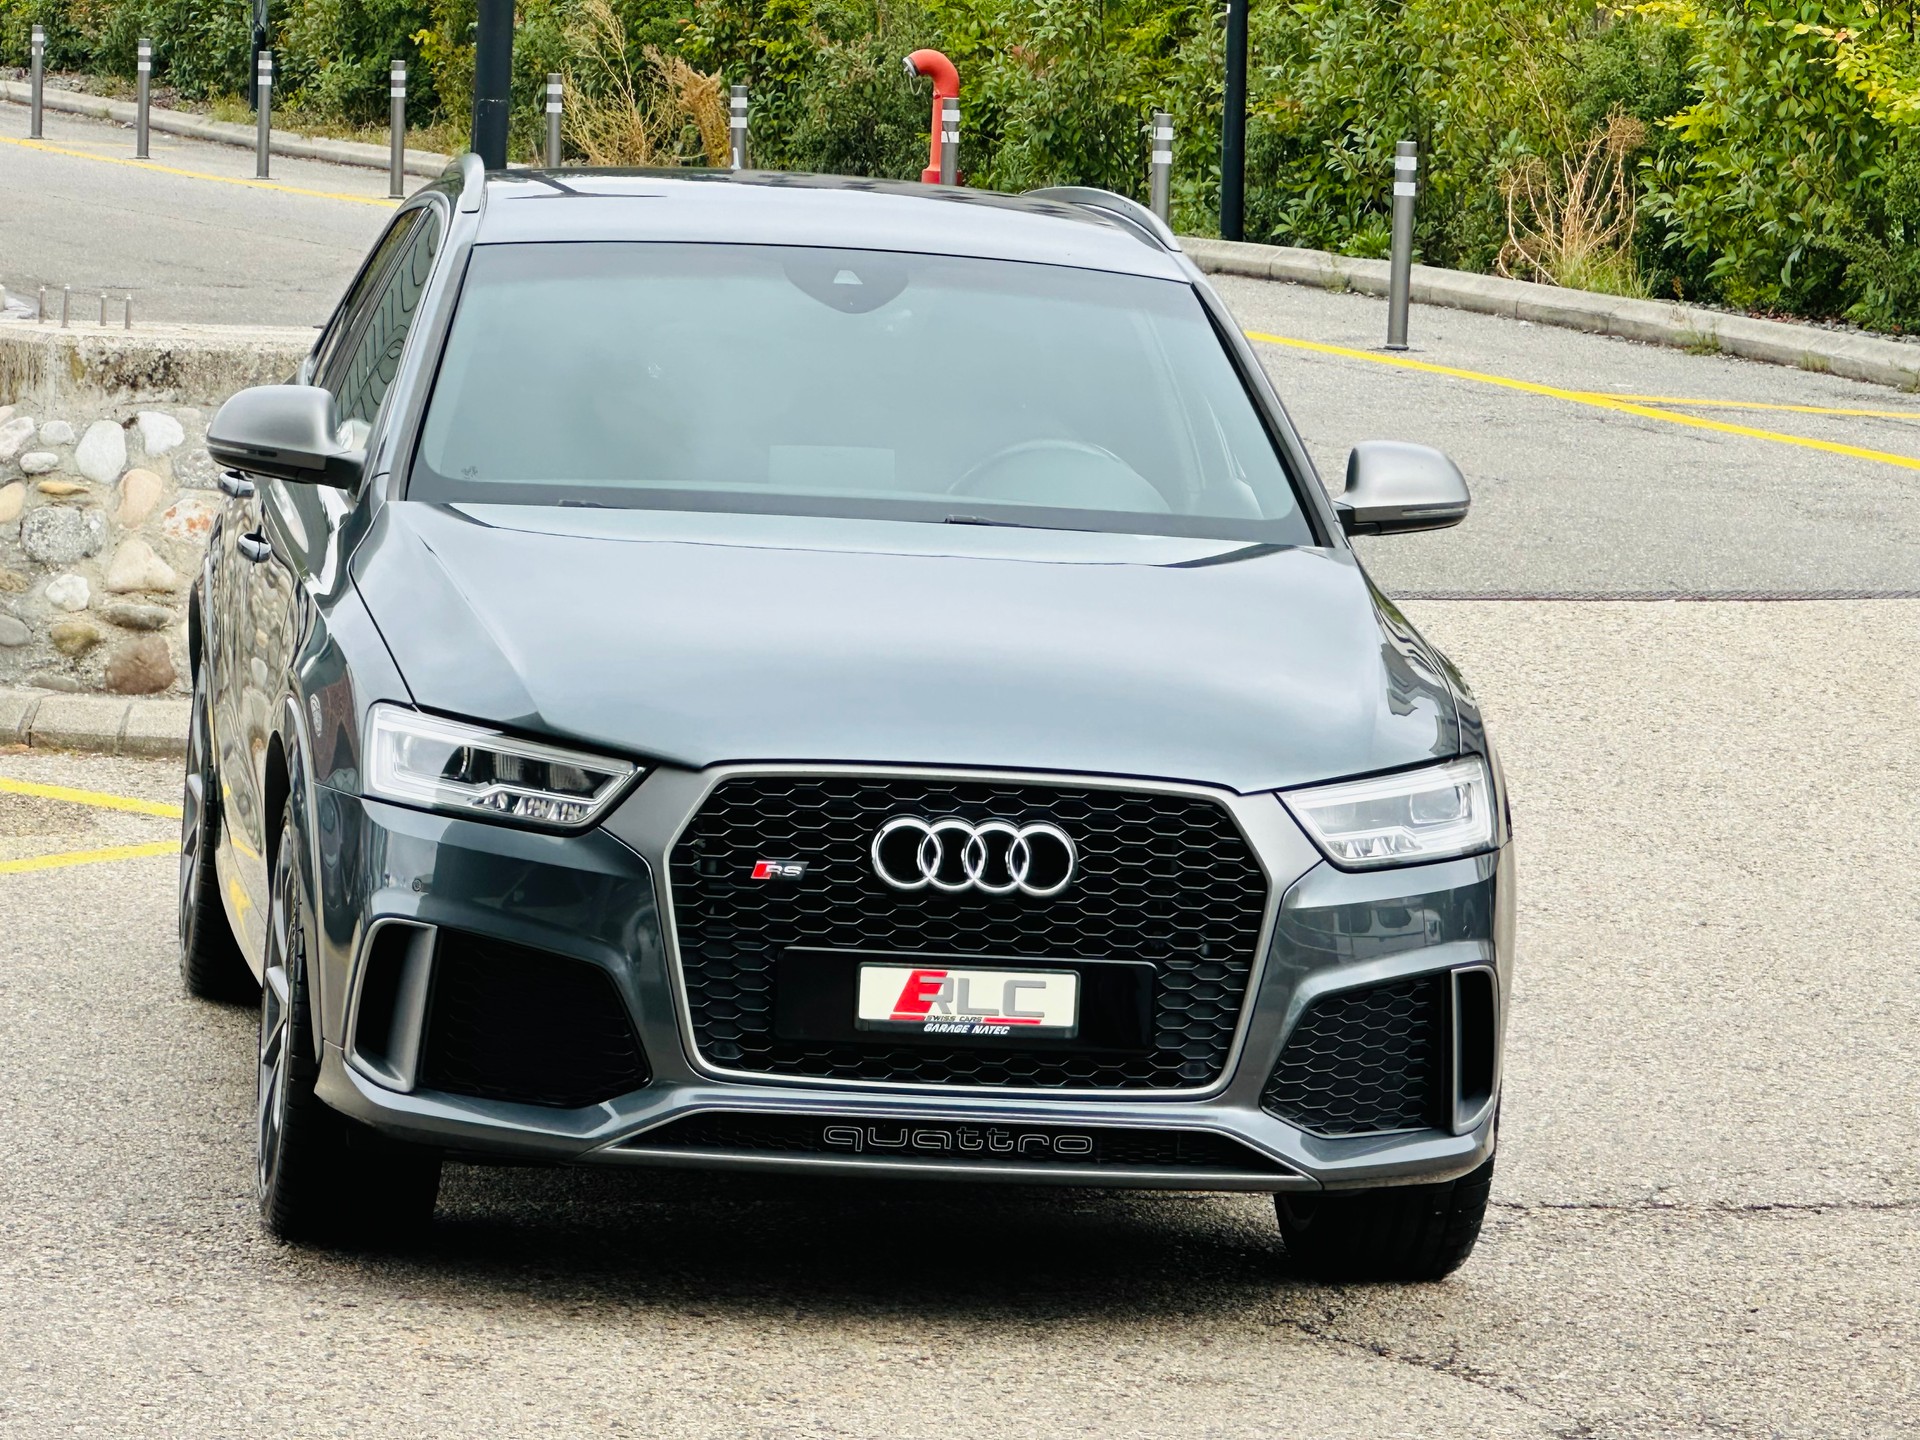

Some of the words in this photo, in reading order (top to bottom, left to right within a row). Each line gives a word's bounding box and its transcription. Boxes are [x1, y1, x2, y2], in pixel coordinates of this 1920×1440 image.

[758, 862, 804, 879] RS
[923, 1023, 970, 1034] GARAGE
[971, 1025, 1010, 1035] NATEC
[823, 1125, 1093, 1154] quattro
